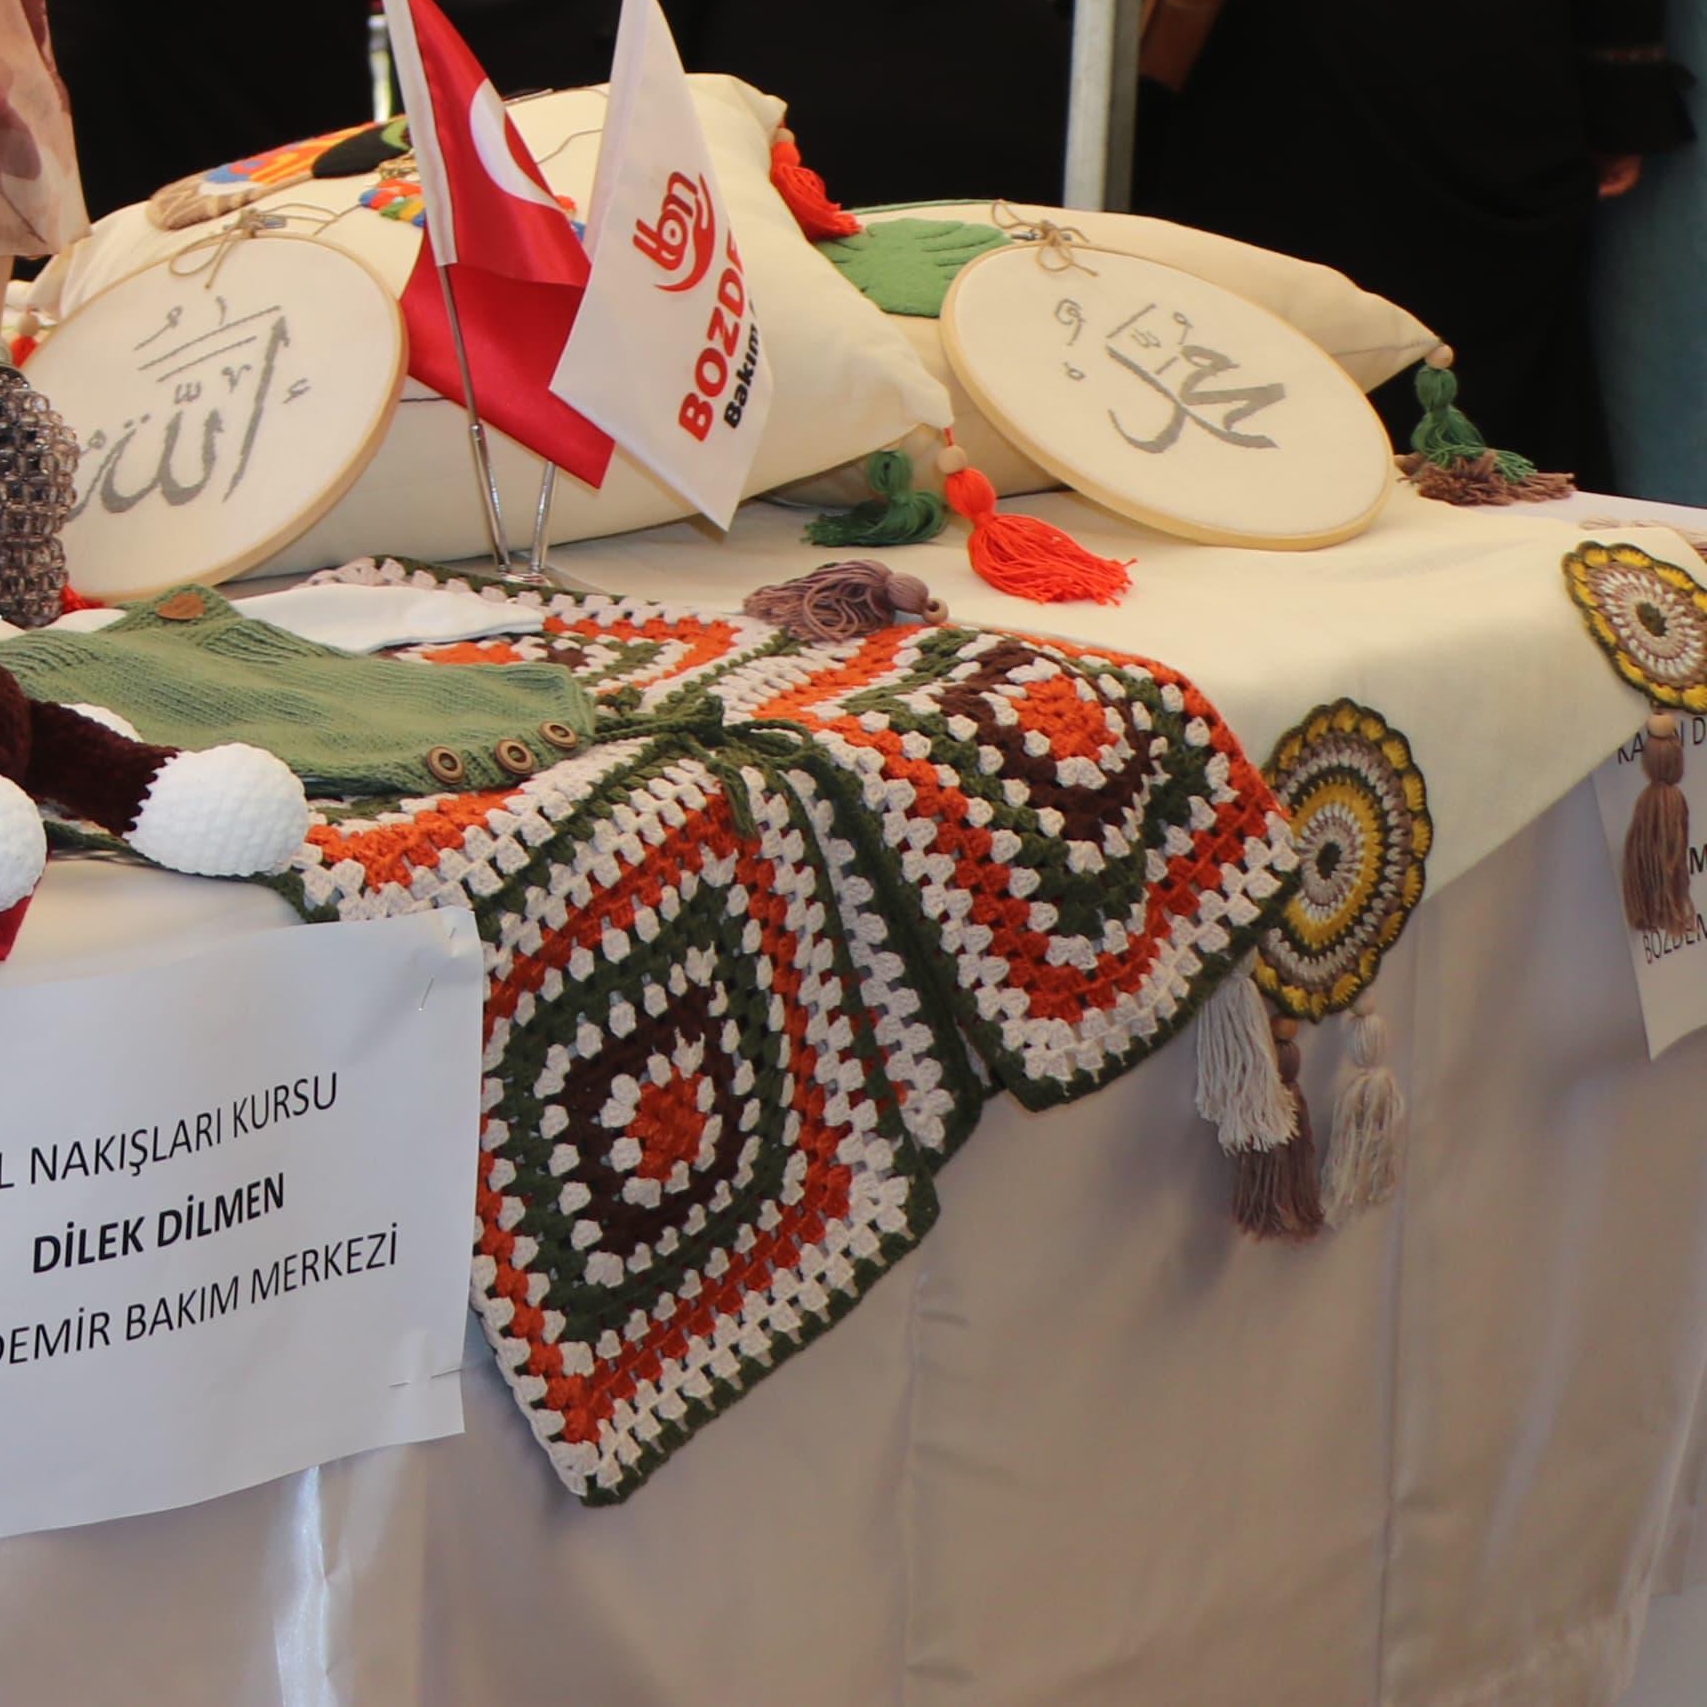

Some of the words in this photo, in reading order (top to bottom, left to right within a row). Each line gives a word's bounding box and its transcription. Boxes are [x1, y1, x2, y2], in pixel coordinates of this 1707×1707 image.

[30, 1107, 221, 1185] NAKIŞLARI
[233, 1071, 337, 1138] KURSU
[32, 1216, 145, 1274] DİLEK
[156, 1172, 284, 1248] DİLMEN
[125, 1275, 239, 1341] BAKIM
[250, 1222, 397, 1304] MERKEZİ
